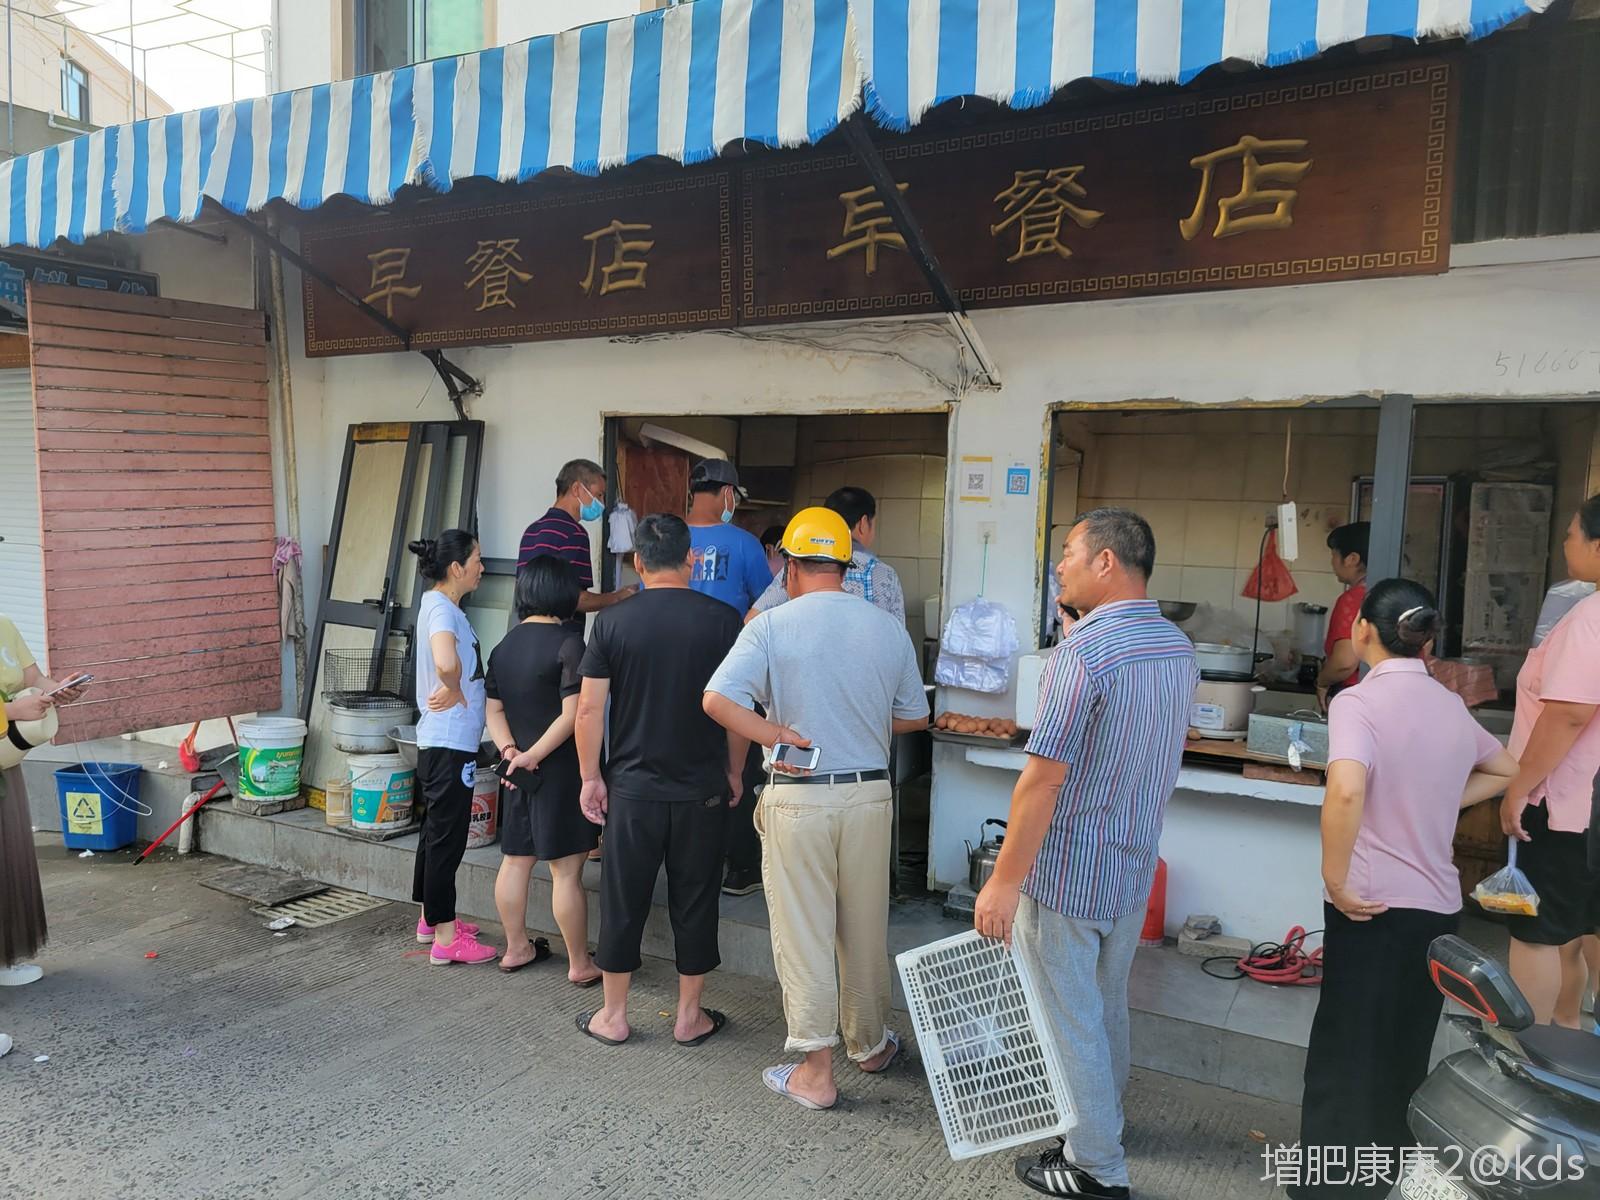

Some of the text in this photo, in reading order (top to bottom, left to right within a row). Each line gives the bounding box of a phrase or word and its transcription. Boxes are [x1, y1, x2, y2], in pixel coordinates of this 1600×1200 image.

[826, 135, 1313, 275] 早餐店
[361, 219, 655, 319] 早餐店
